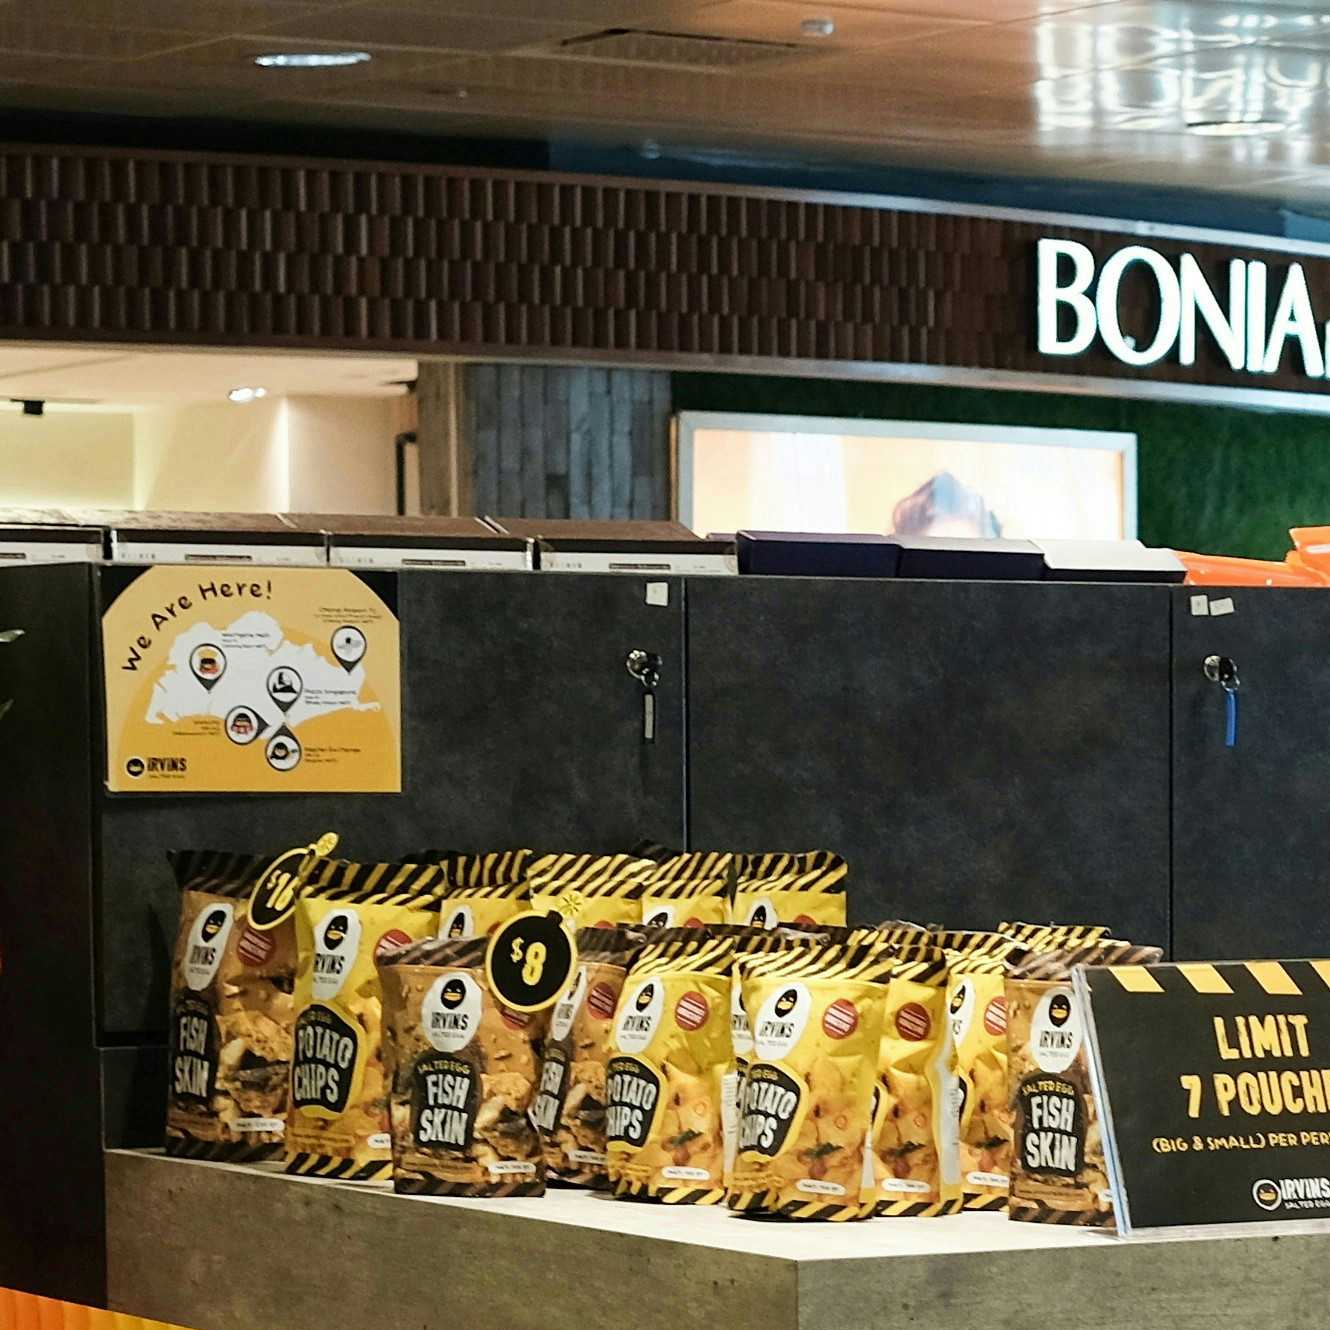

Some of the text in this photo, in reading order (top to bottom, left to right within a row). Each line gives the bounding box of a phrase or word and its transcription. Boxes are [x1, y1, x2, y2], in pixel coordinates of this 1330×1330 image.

[1037, 238, 1326, 378] BONIA
[122, 580, 272, 672] We Are Here!
[147, 756, 187, 773] IRVINS
[314, 952, 345, 975] RVINS
[510, 937, 547, 986] $8
[179, 1015, 208, 1056] FISH
[431, 1012, 469, 1030] IRVINS
[1039, 1030, 1073, 1049] IRVINS
[1213, 1013, 1312, 1061] LIMIT
[298, 1025, 354, 1070] POTATO
[174, 1055, 210, 1098] SKIN
[293, 1063, 340, 1104] CHIPS
[426, 1073, 470, 1109] FISH
[1180, 1075, 1202, 1119] 7
[419, 1107, 469, 1146] SKIN
[606, 1105, 643, 1140] HIPS
[1031, 1094, 1076, 1133] FISH
[1025, 1131, 1078, 1172] SKIN
[1152, 1137, 1188, 1153] (BIG
[1192, 1136, 1205, 1151] &
[1207, 1132, 1267, 1151] SMALL)
[1269, 1132, 1299, 1148] PER
